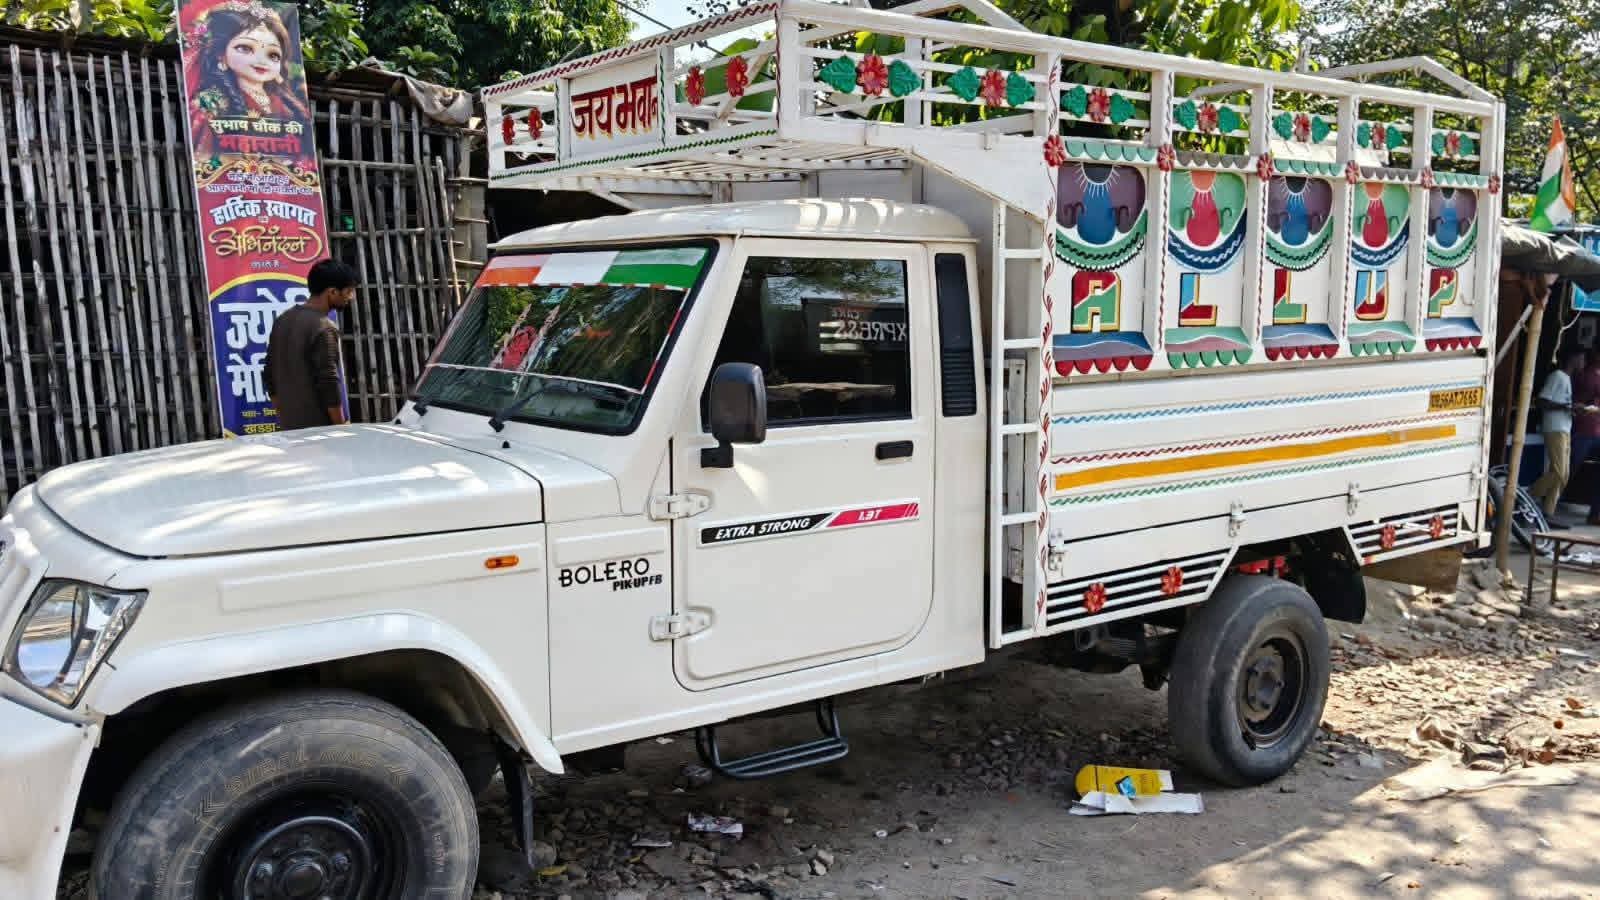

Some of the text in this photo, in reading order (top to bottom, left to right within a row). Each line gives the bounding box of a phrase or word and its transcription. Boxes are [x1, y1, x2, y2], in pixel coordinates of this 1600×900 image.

[571, 86, 615, 139] जय
[252, 118, 281, 134] चौक
[284, 120, 303, 135] की
[220, 134, 302, 153] महारानी
[210, 195, 318, 226] हार्दिक स्वागत
[715, 517, 811, 540] EXTRA STRONG
[558, 558, 650, 588] BOLERO
